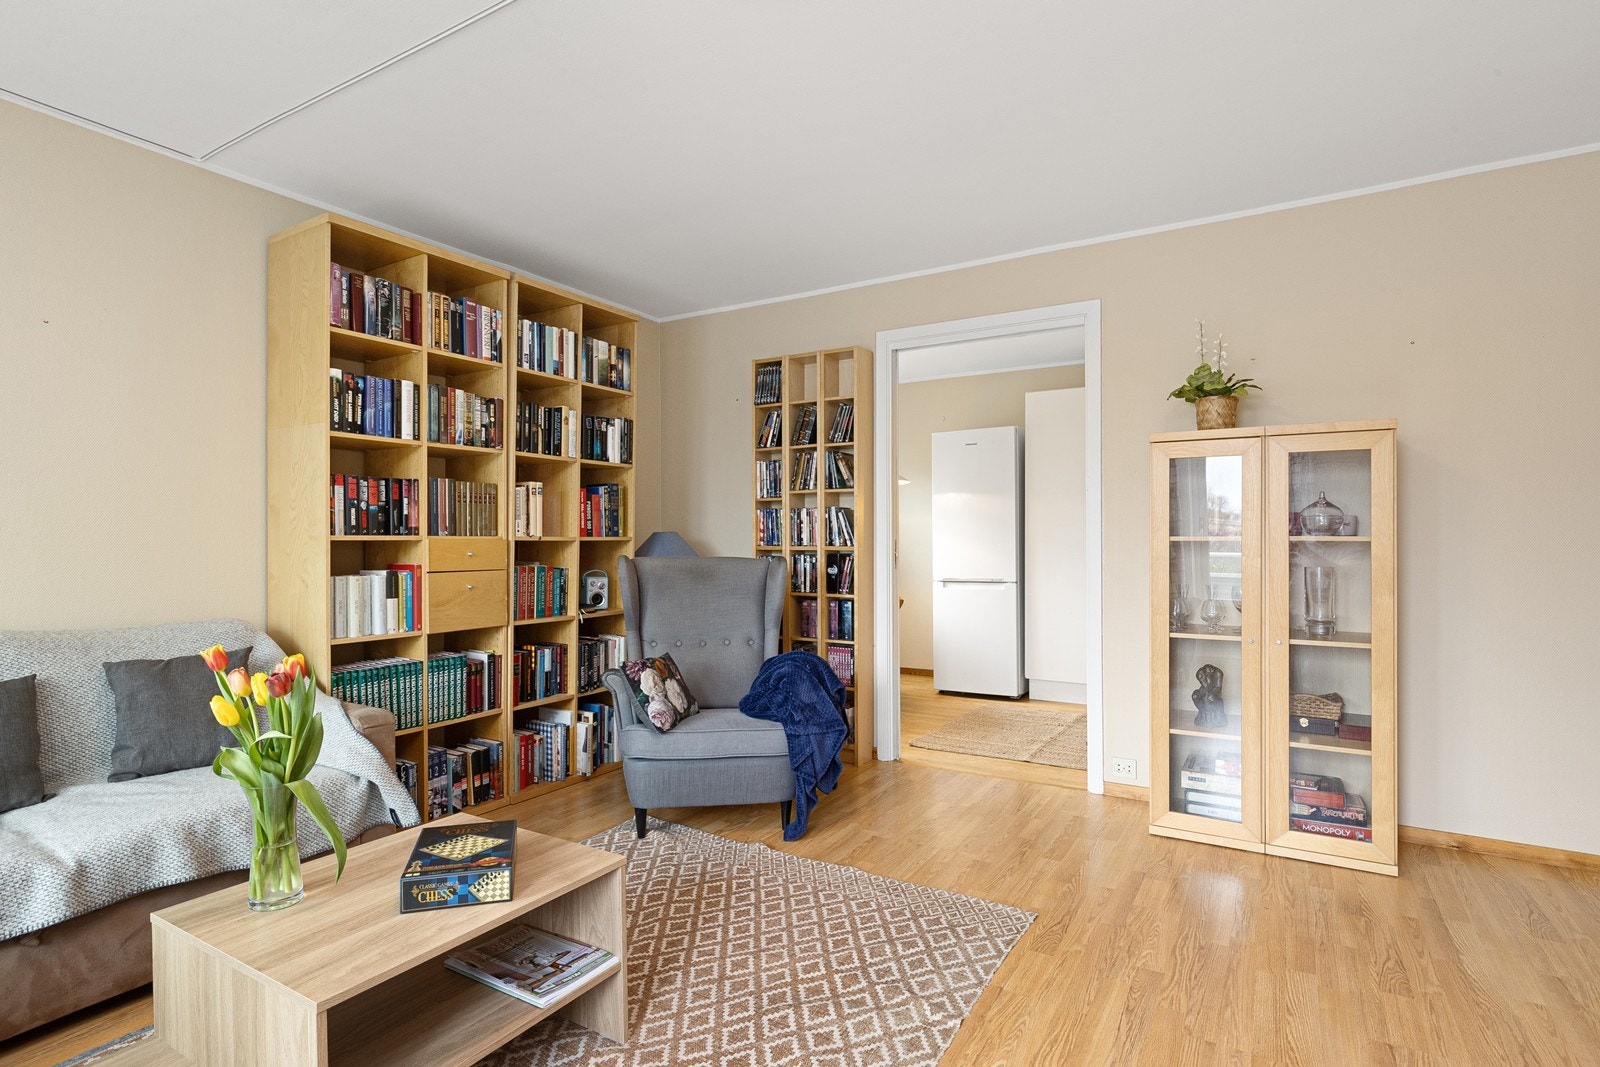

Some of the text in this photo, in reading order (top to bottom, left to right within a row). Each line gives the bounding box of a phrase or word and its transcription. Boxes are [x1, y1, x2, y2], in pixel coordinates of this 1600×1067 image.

[434, 766, 439, 776] 2
[443, 764, 447, 775] 3
[1302, 824, 1351, 837] MONOPOLY
[418, 888, 454, 903] CHESS
